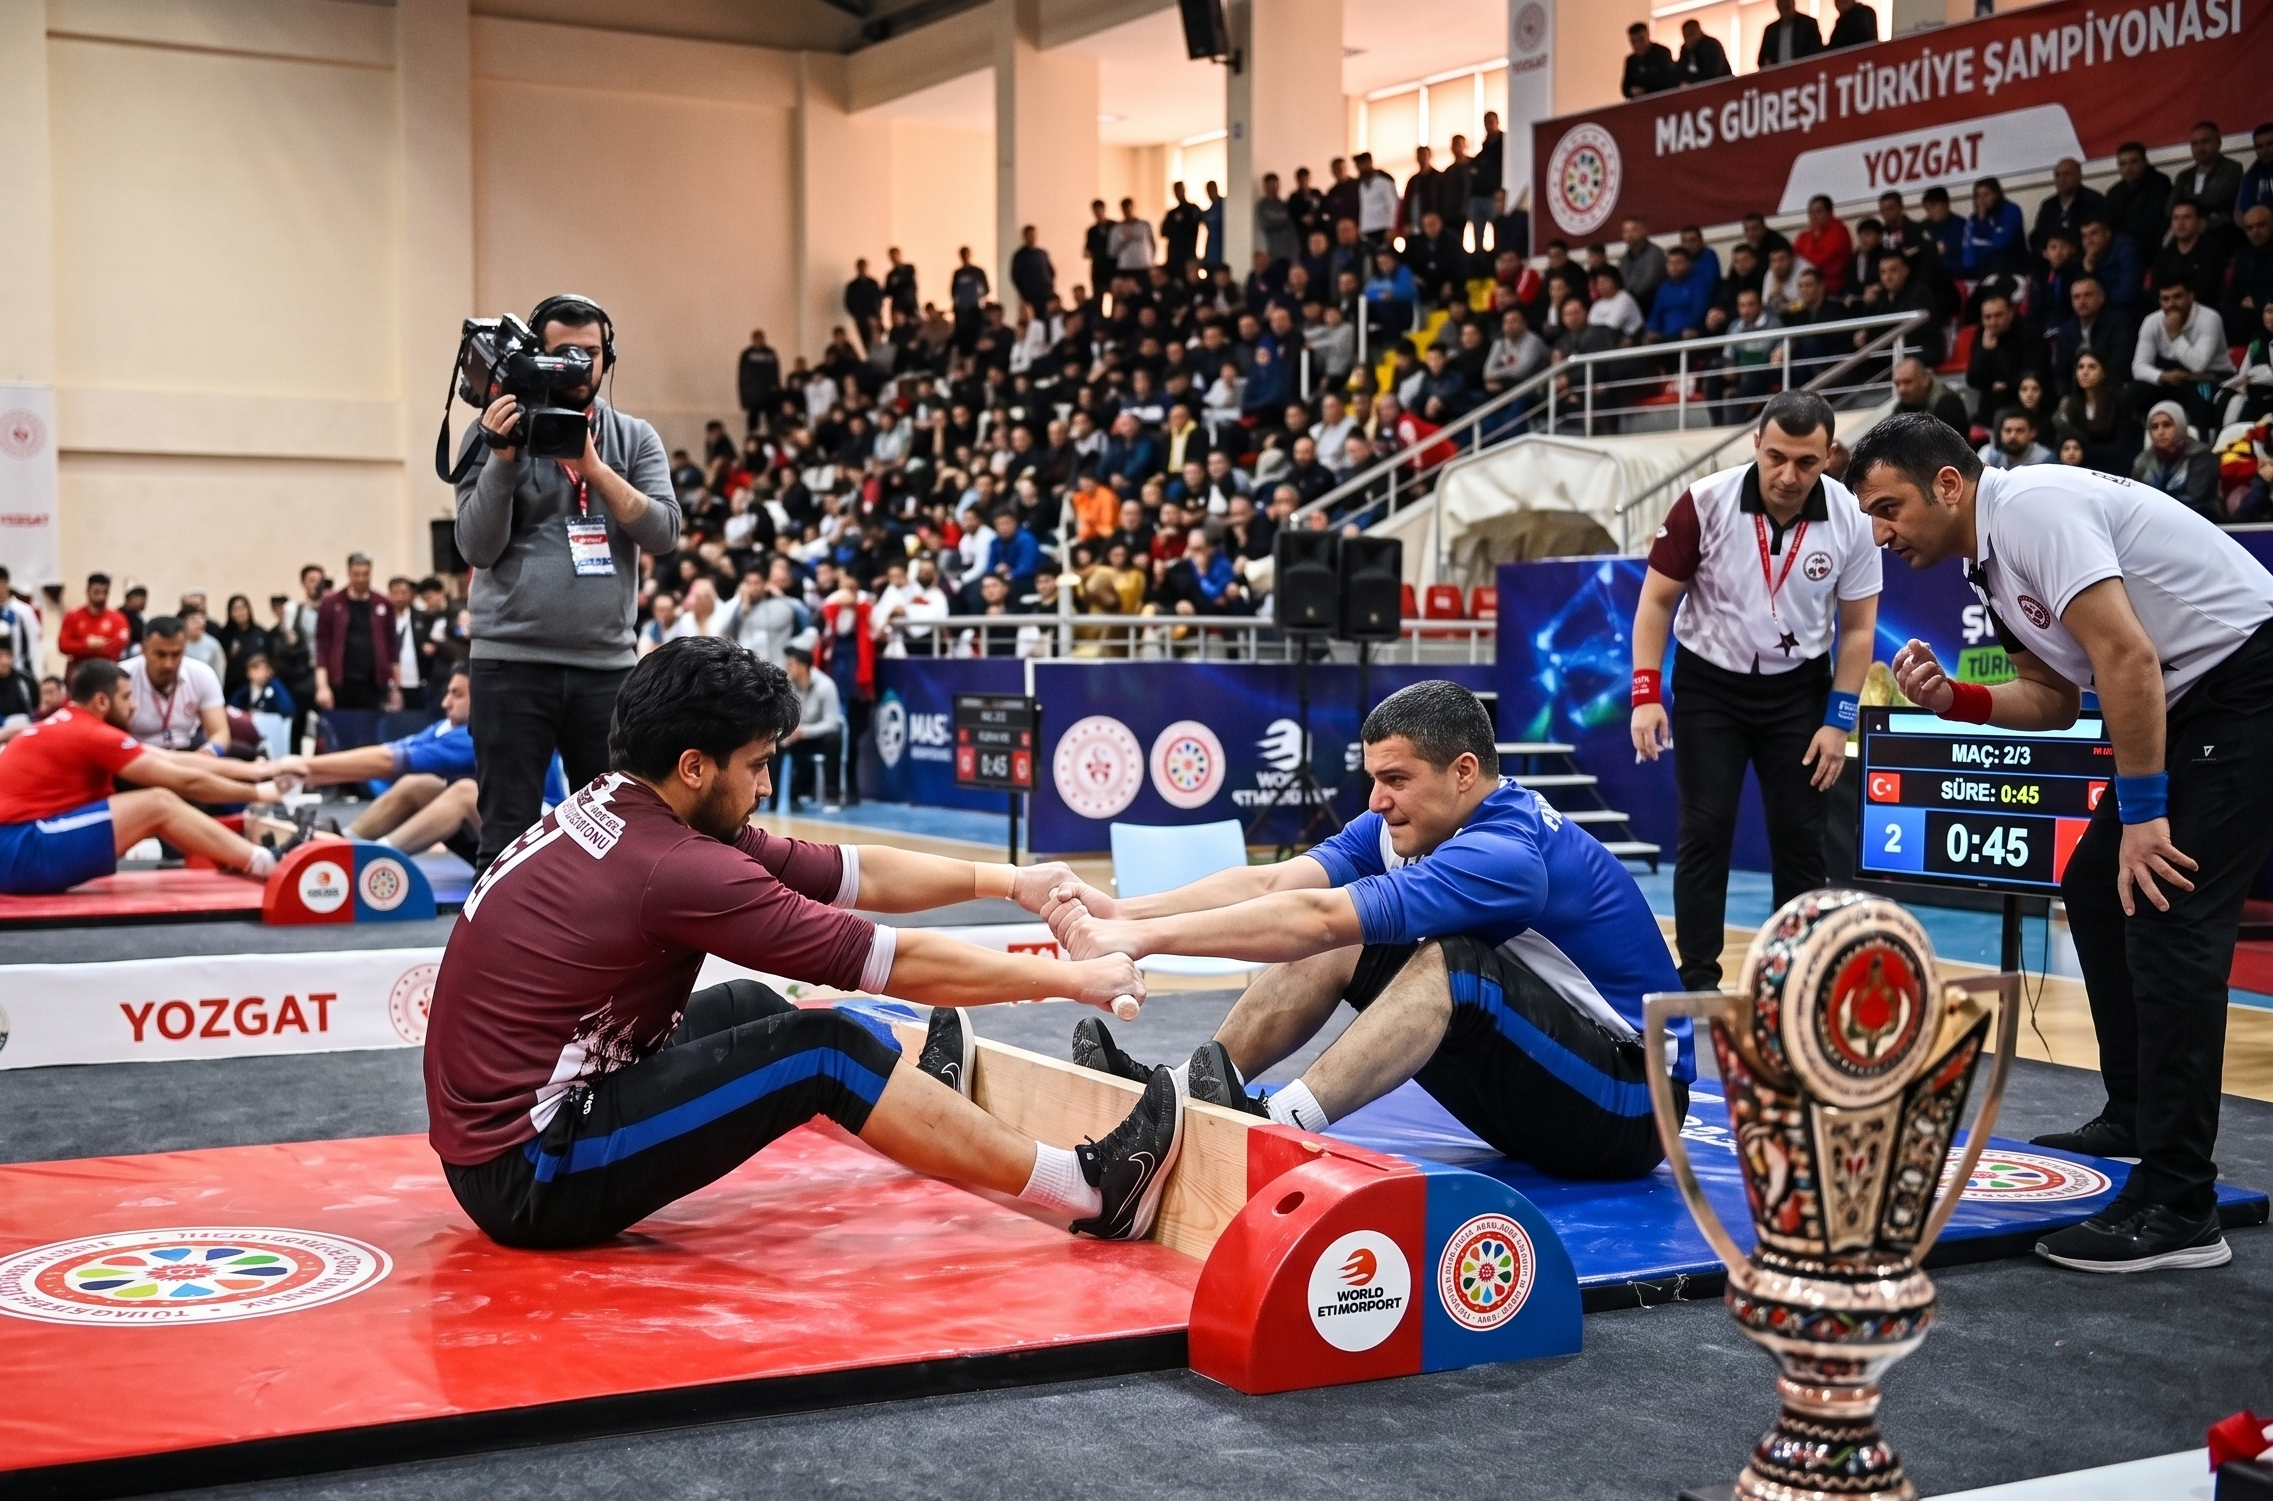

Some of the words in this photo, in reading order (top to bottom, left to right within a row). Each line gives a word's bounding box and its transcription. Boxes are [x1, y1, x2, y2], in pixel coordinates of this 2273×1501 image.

[1655, 106, 1714, 156] MAS
[1719, 71, 1829, 134] GÜREŞİ
[1835, 46, 1975, 118] TÜRKİYE
[1863, 133, 1984, 188] YOZGAT
[1952, 744, 1999, 768] MAÇ:
[2003, 746, 2031, 765] 2/3
[1941, 778, 1996, 801] SÜRE:
[2000, 785, 2040, 804] 0:45
[1884, 823, 1902, 853] 2
[1946, 823, 2029, 867] 0:45
[119, 993, 338, 1043] YOZGAT
[1337, 1287, 1384, 1302] WORLD
